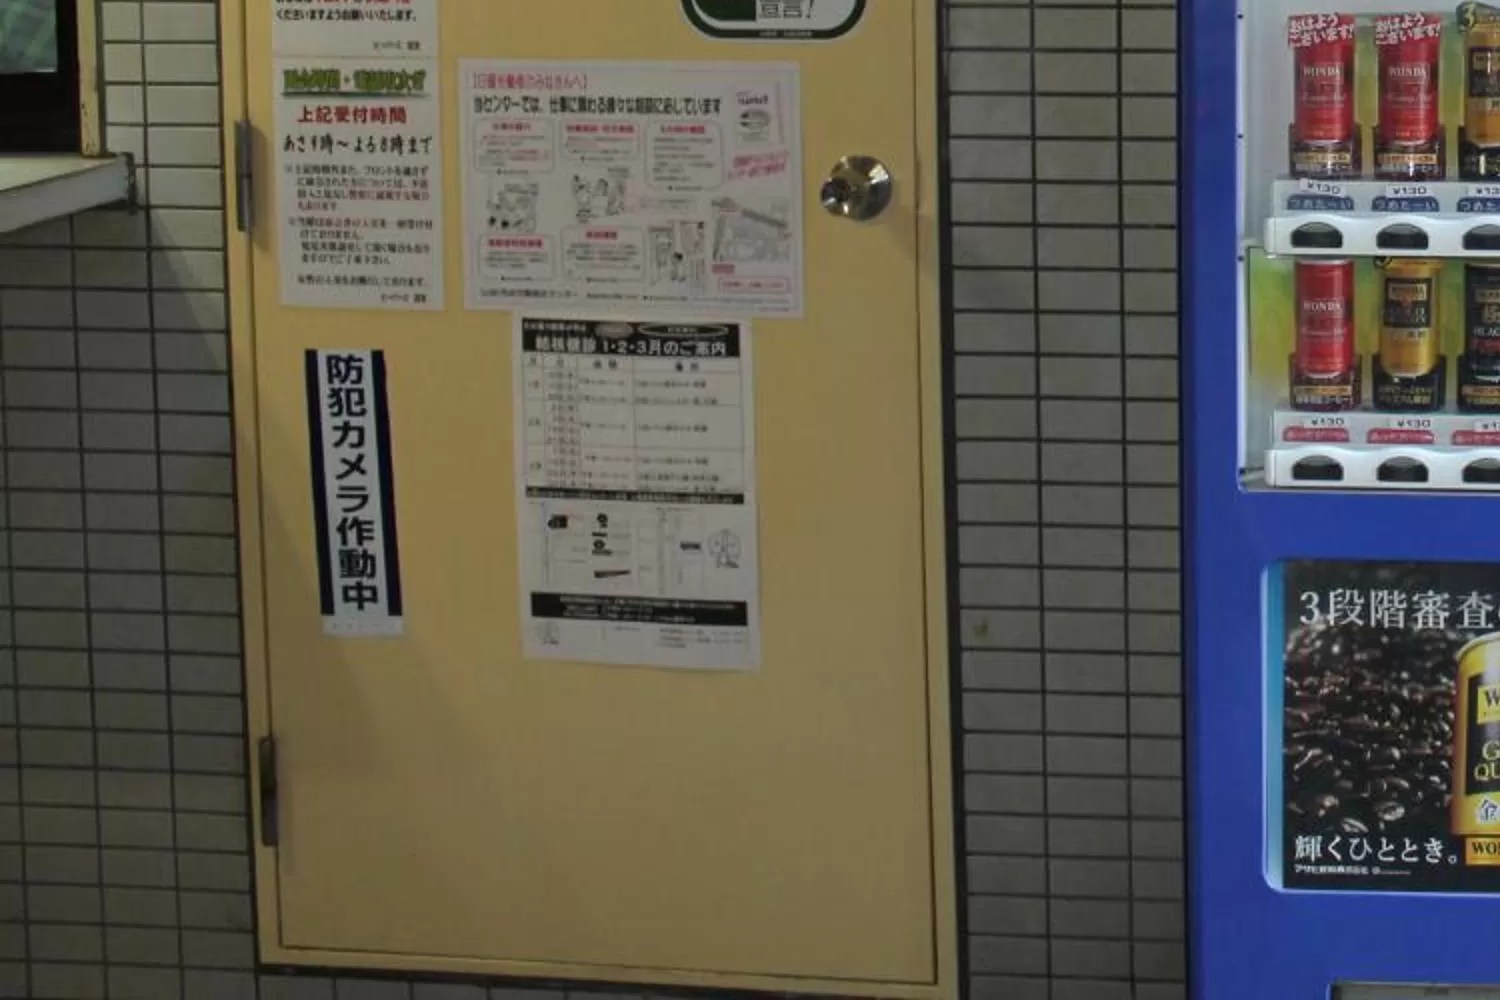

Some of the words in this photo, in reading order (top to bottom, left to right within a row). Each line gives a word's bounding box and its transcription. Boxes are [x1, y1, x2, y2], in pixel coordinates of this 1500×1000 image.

[297, 105, 407, 124] 上記受付時間
[326, 354, 379, 612] 防犯カメラ作動中
[1294, 834, 1458, 866] 輝くひととき。
